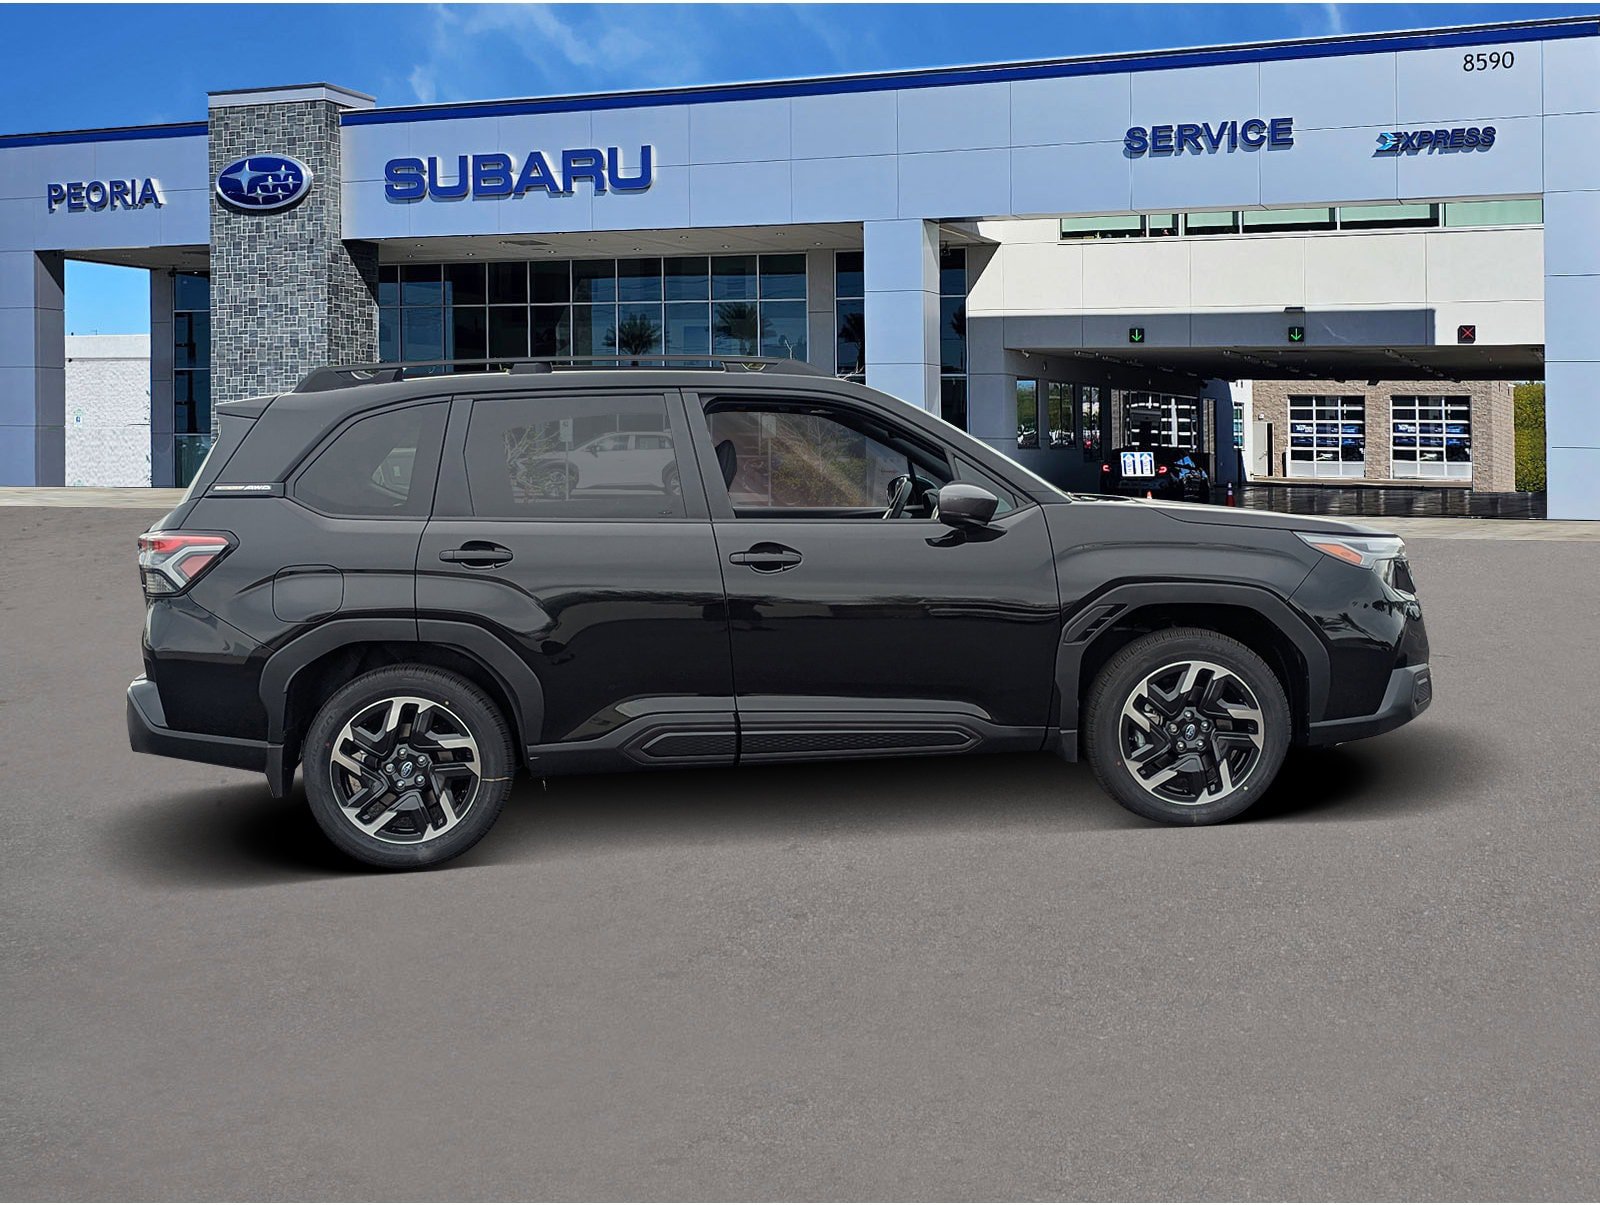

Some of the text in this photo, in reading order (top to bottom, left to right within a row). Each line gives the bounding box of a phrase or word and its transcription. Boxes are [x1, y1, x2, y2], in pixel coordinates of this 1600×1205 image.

[1463, 51, 1515, 72] 8590
[1124, 117, 1294, 155] SERVICE
[1375, 126, 1497, 152] EXPRESS
[384, 144, 653, 202] SUBARU
[47, 178, 162, 212] PEORIA
